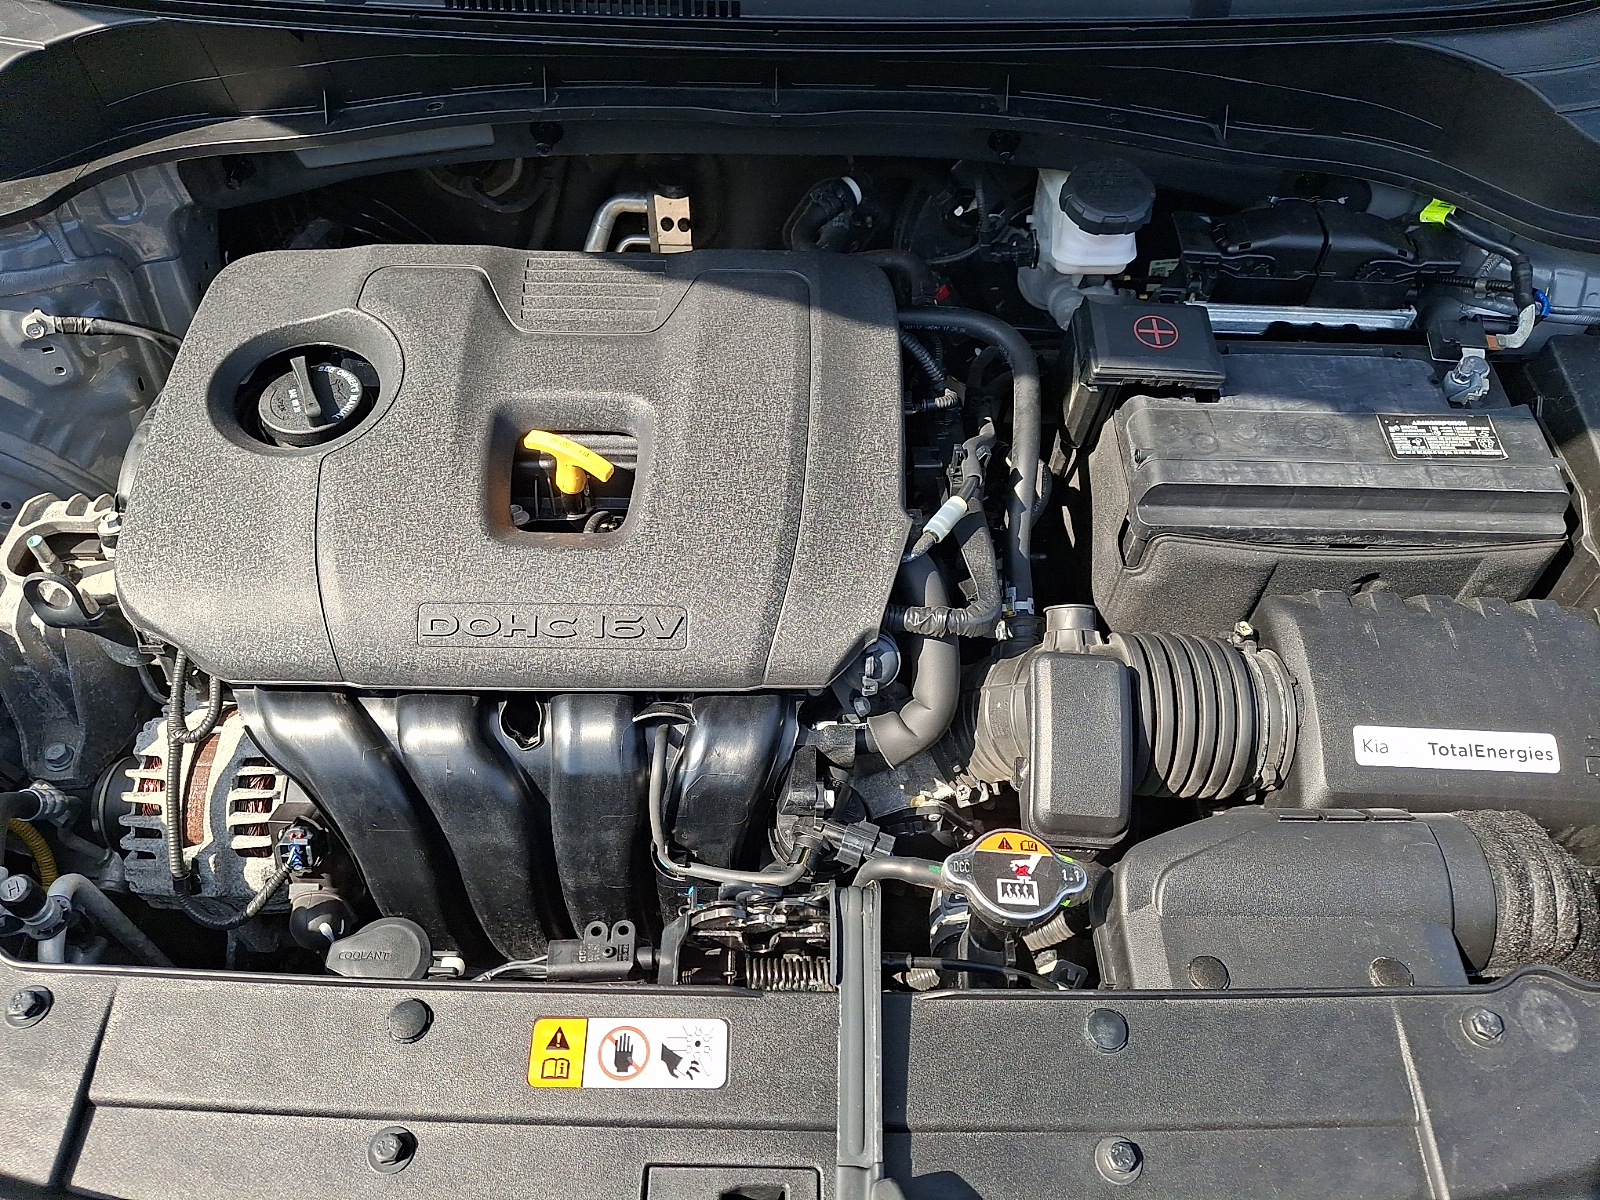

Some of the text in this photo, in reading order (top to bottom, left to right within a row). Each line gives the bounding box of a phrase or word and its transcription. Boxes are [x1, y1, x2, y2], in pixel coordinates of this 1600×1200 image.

[332, 395, 359, 419] MANUAL
[422, 613, 685, 640] DOHC 16V
[1362, 738, 1554, 763] Kia TotalEnergies
[953, 860, 971, 873] DCC
[1061, 868, 1081, 883] 1.1
[338, 950, 391, 961] COOLANT
